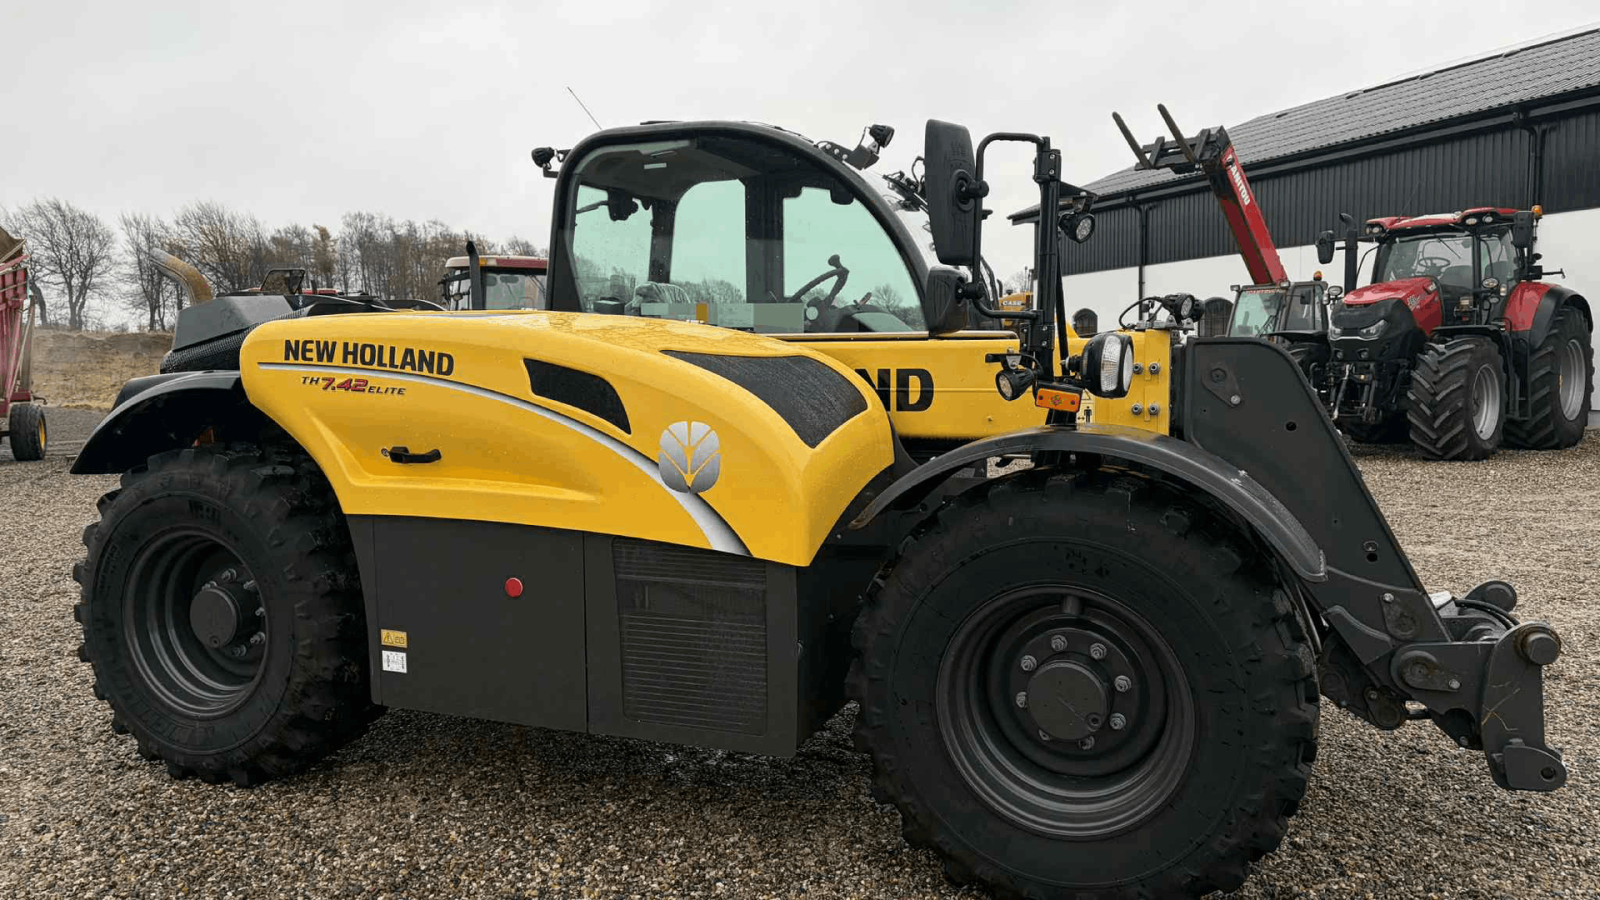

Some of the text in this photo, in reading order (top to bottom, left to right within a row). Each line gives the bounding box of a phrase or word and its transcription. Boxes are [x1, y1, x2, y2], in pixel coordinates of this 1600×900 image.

[285, 339, 454, 376] NEW HOLLAND
[367, 385, 406, 396] ELITE
